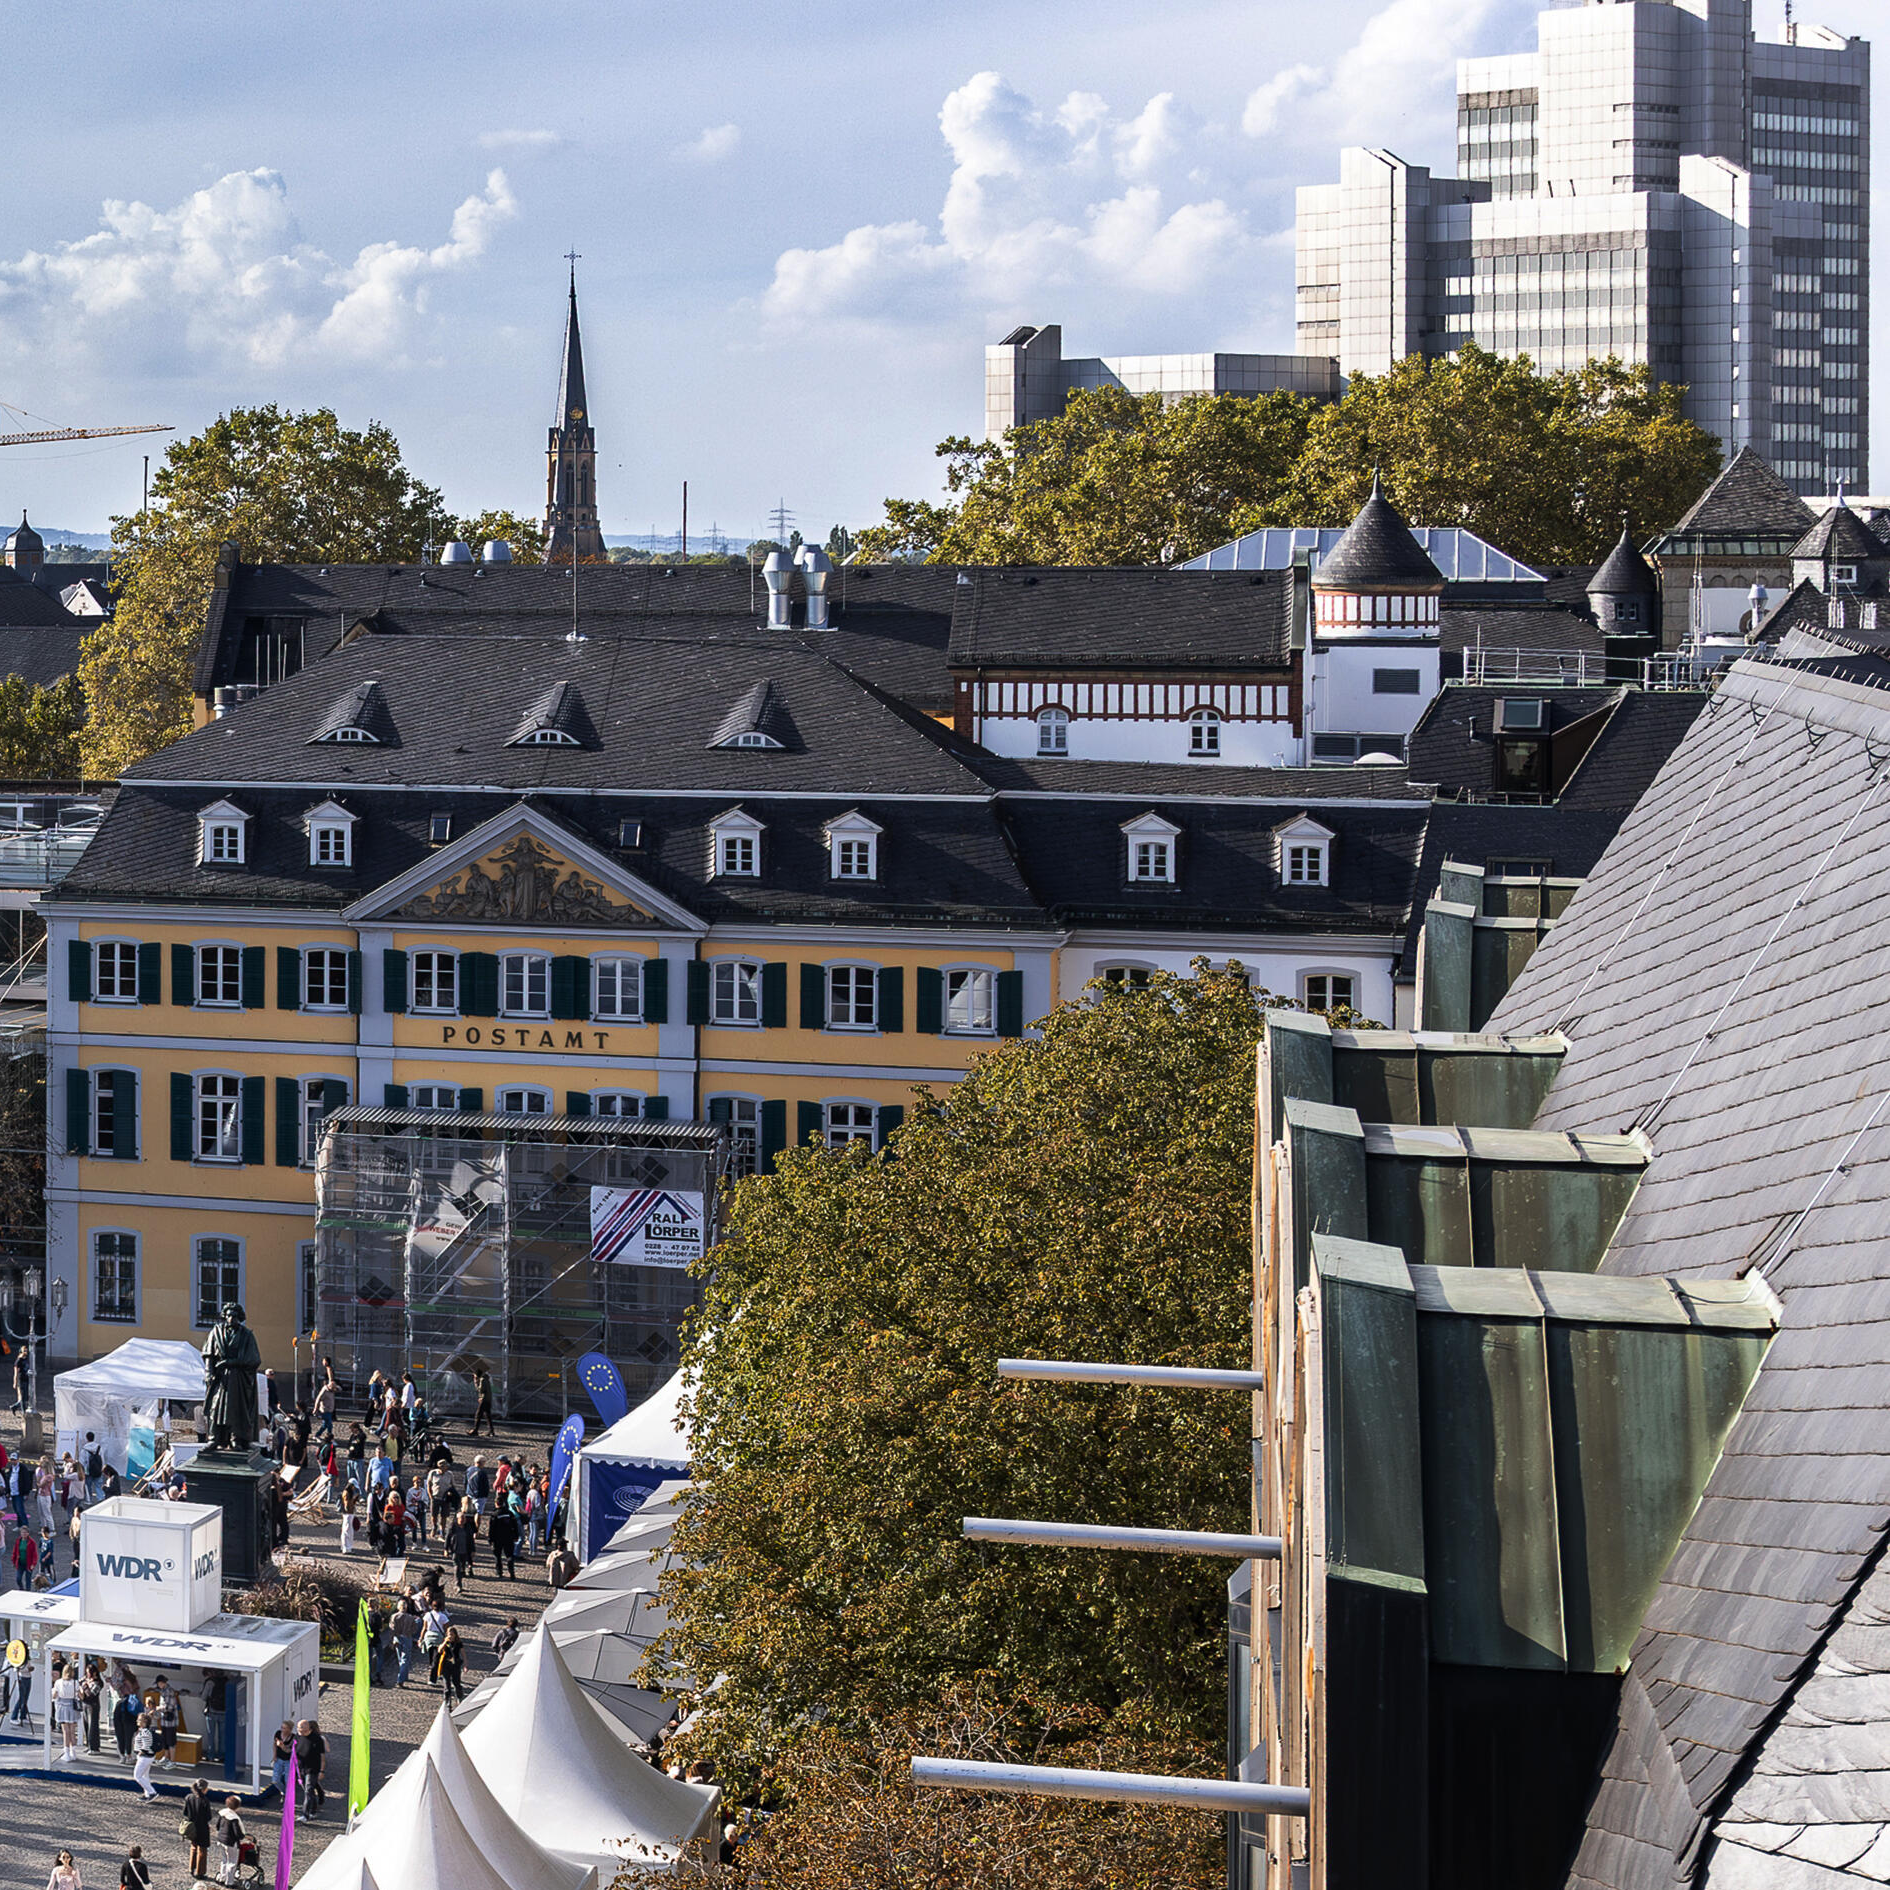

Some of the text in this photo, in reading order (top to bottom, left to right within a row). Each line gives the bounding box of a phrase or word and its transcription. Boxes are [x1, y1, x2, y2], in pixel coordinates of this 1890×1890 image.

[443, 1026, 609, 1050] POSTAMT
[645, 1223, 700, 1242] LÖRPER
[96, 1553, 163, 1582] WDR
[194, 1550, 214, 1581] WDR
[111, 1633, 213, 1652] WDR
[293, 1671, 313, 1703] WDR
